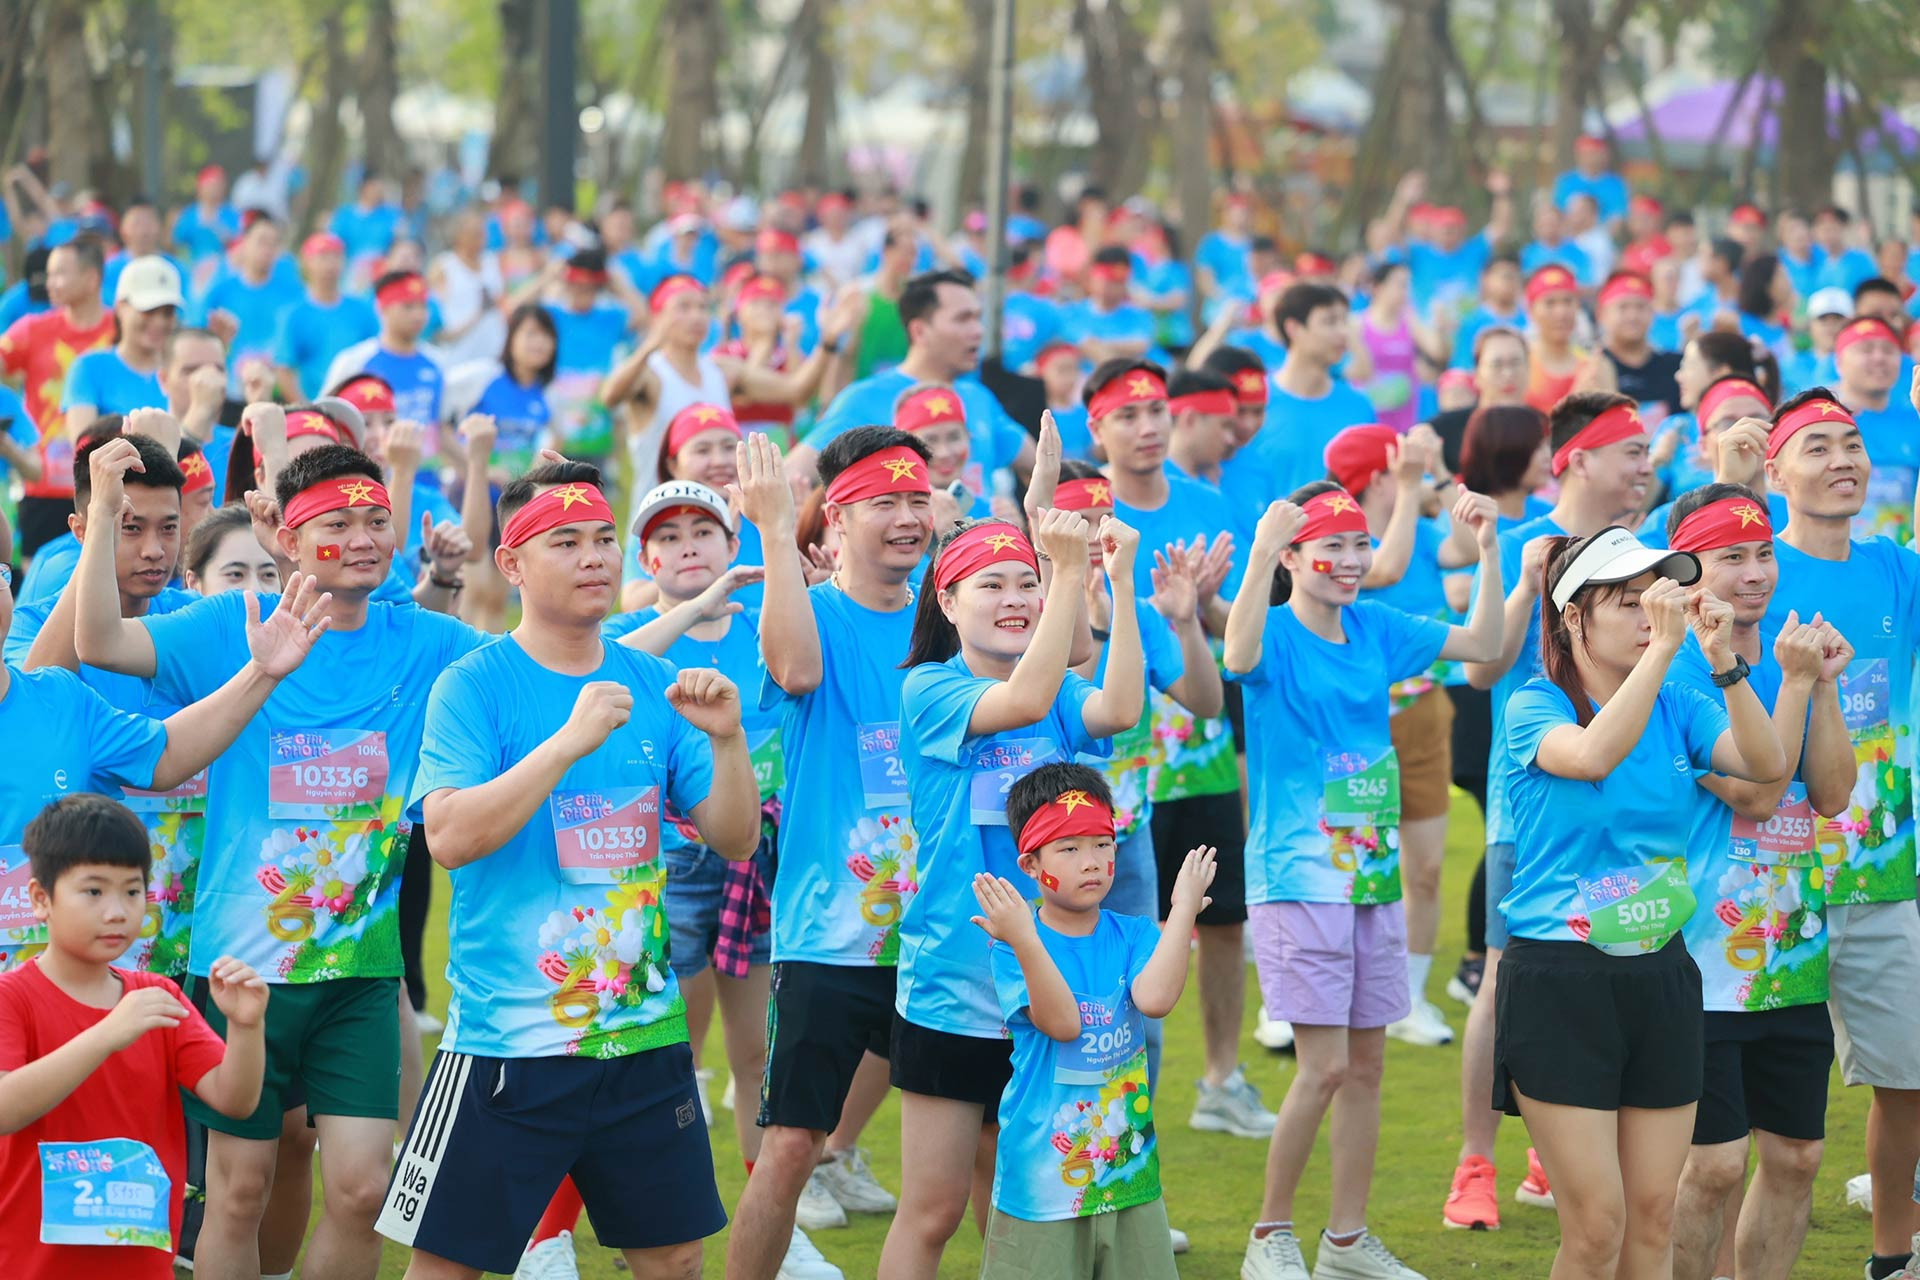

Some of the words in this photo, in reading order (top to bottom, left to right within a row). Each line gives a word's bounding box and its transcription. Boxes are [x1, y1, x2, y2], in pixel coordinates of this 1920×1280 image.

[1841, 692, 1875, 714] 086
[357, 745, 386, 757] 10Km
[292, 765, 369, 788] 10336
[1347, 778, 1388, 797] 5245
[575, 826, 647, 850] 10339
[1734, 846, 1751, 856] 130
[1617, 898, 1671, 926] 5013
[1081, 1022, 1132, 1054] 2005
[402, 1161, 428, 1195] Wa
[393, 1190, 419, 1222] ng
